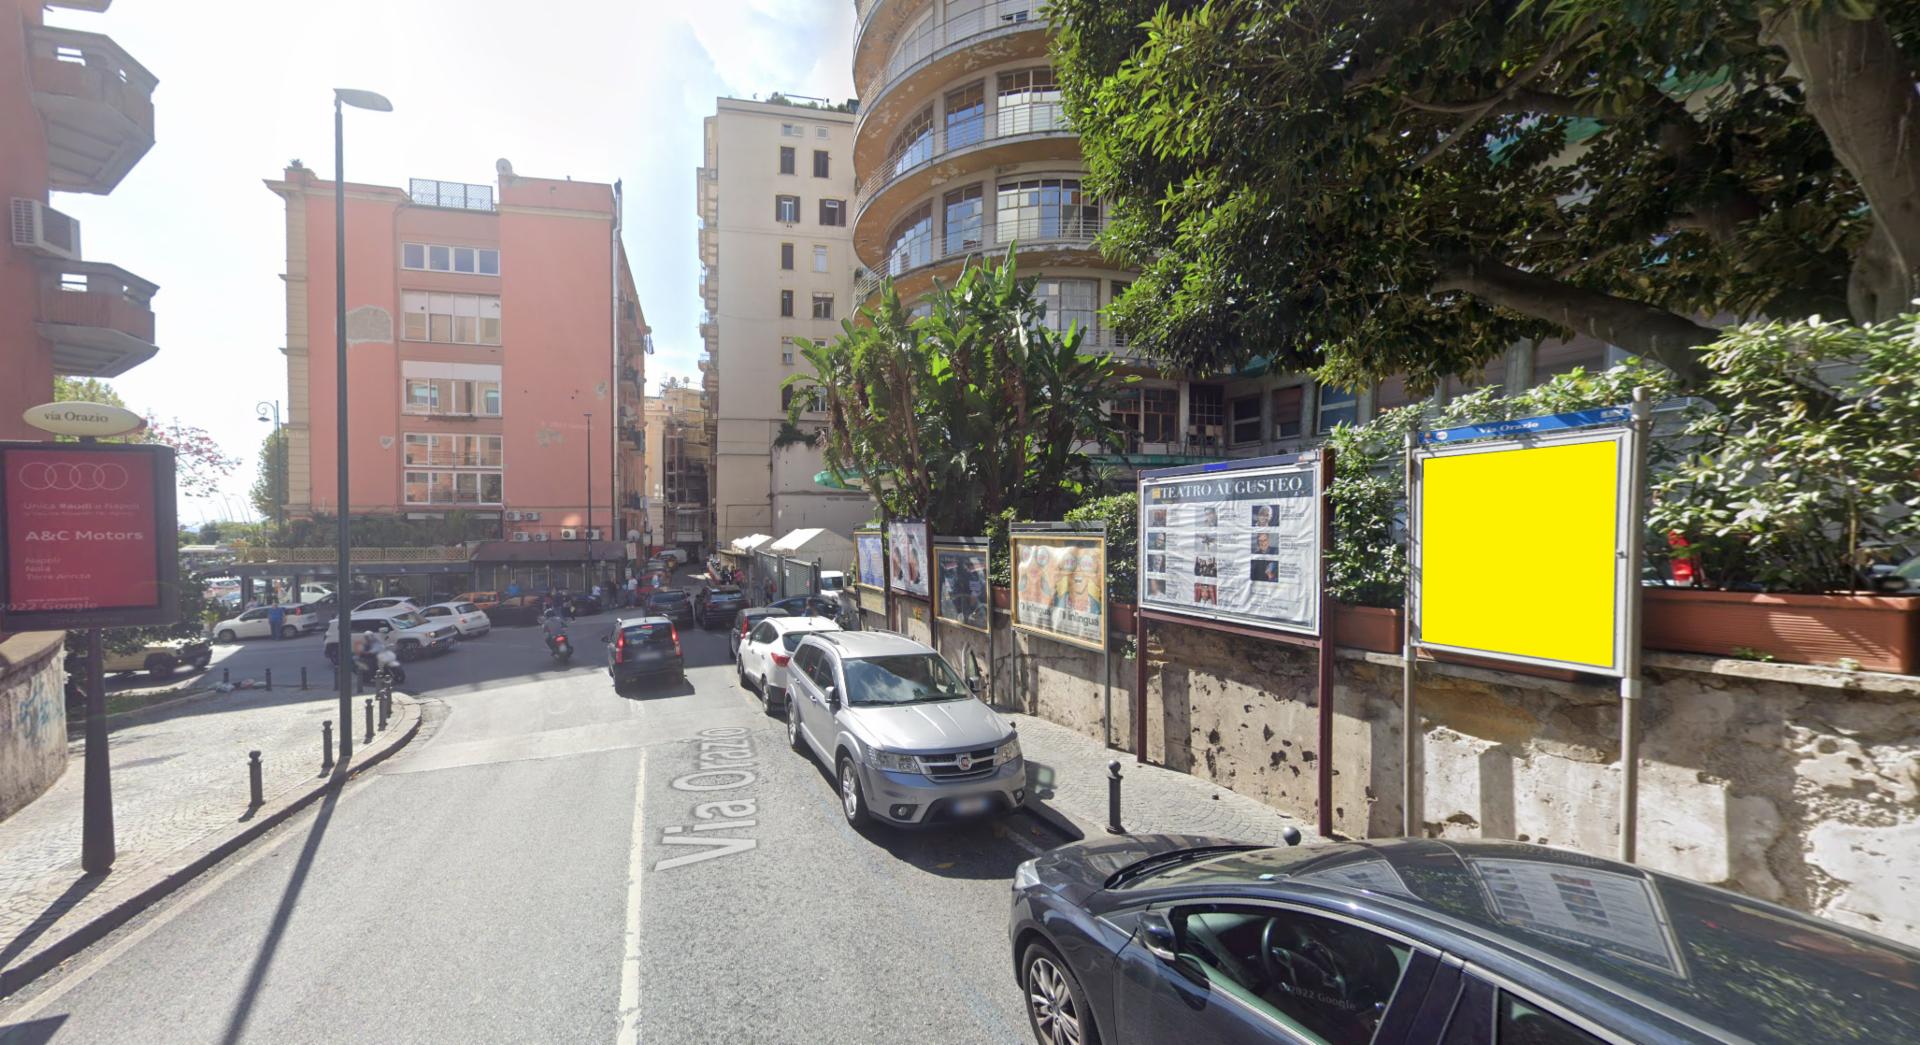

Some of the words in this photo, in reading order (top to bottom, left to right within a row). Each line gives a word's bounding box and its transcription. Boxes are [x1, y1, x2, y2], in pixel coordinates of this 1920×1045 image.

[44, 411, 61, 421] via
[64, 407, 109, 423] Orazio
[1160, 484, 1211, 499] TEATRO
[1215, 476, 1303, 496] AUGUSTEO
[25, 530, 70, 542] A&C
[75, 531, 144, 541] Motors
[1067, 609, 1099, 627] inlingua
